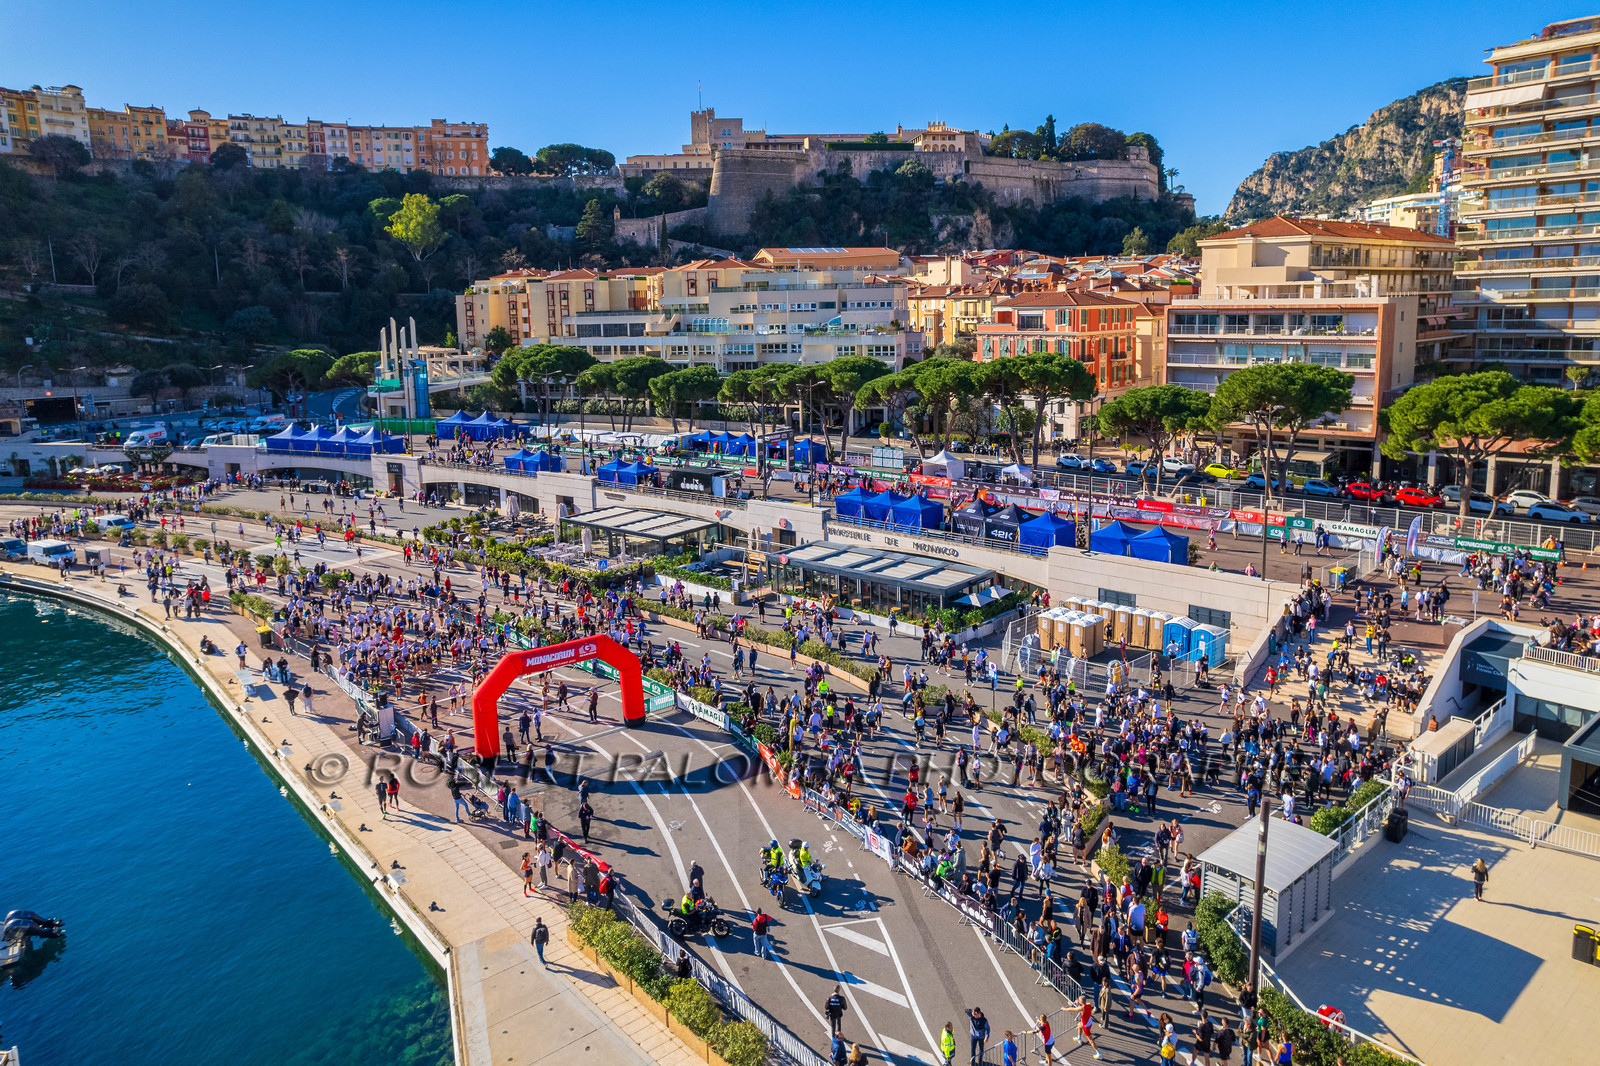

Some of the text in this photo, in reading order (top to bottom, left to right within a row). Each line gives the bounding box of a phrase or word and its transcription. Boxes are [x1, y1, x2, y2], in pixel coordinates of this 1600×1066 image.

[991, 529, 1013, 540] 42K
[1332, 524, 1377, 536] GRAMAGLIA
[885, 536, 899, 547] DE
[913, 541, 959, 557] MONACO
[526, 648, 575, 667] MONACORUN
